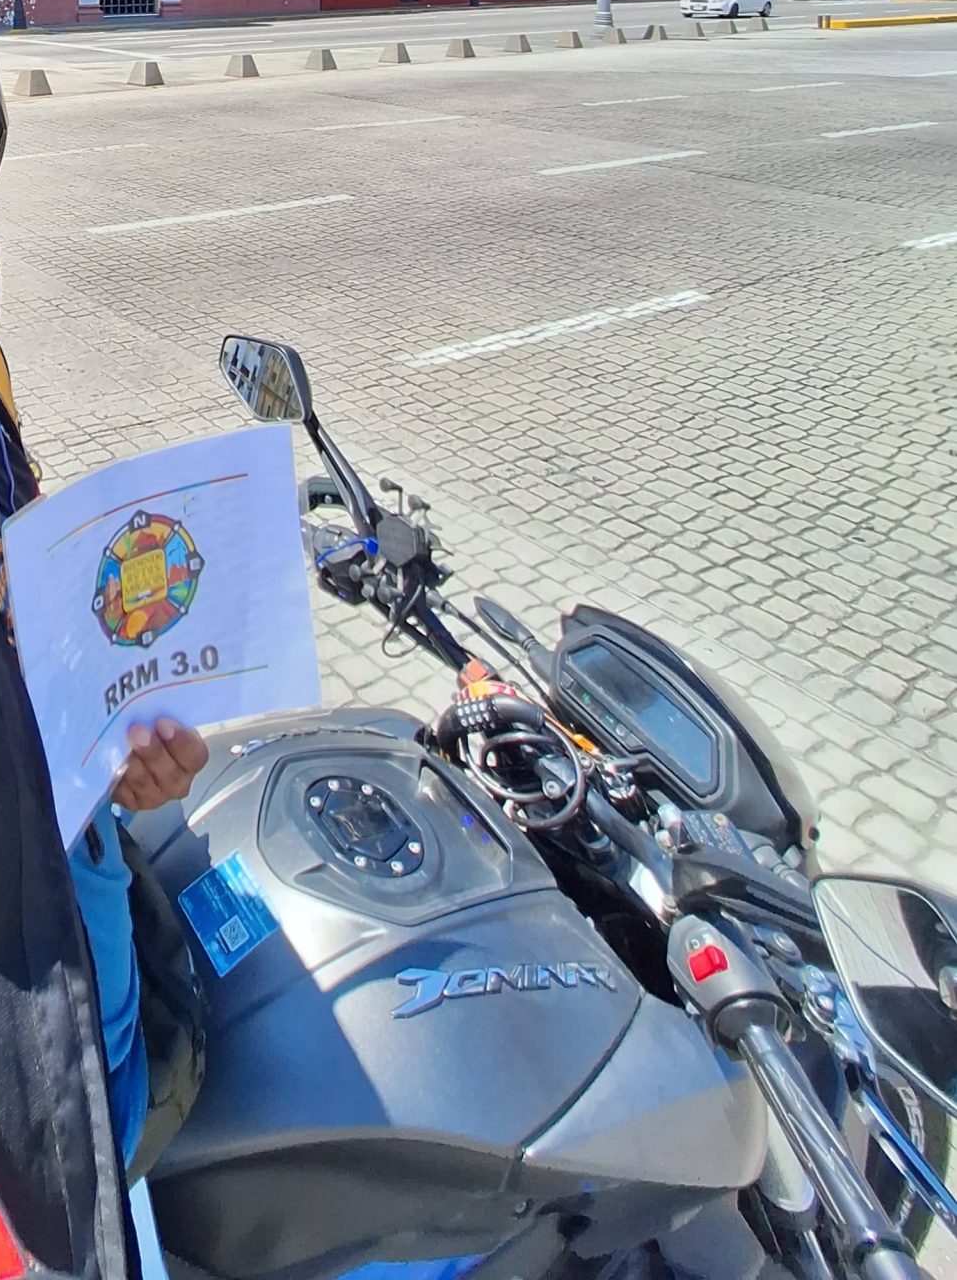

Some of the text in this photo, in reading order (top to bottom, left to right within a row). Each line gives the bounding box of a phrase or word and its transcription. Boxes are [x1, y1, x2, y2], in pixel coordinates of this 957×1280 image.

[133, 515, 146, 528] N
[105, 646, 219, 715] RRM 3.0
[391, 962, 618, 1019] DOMINAR
